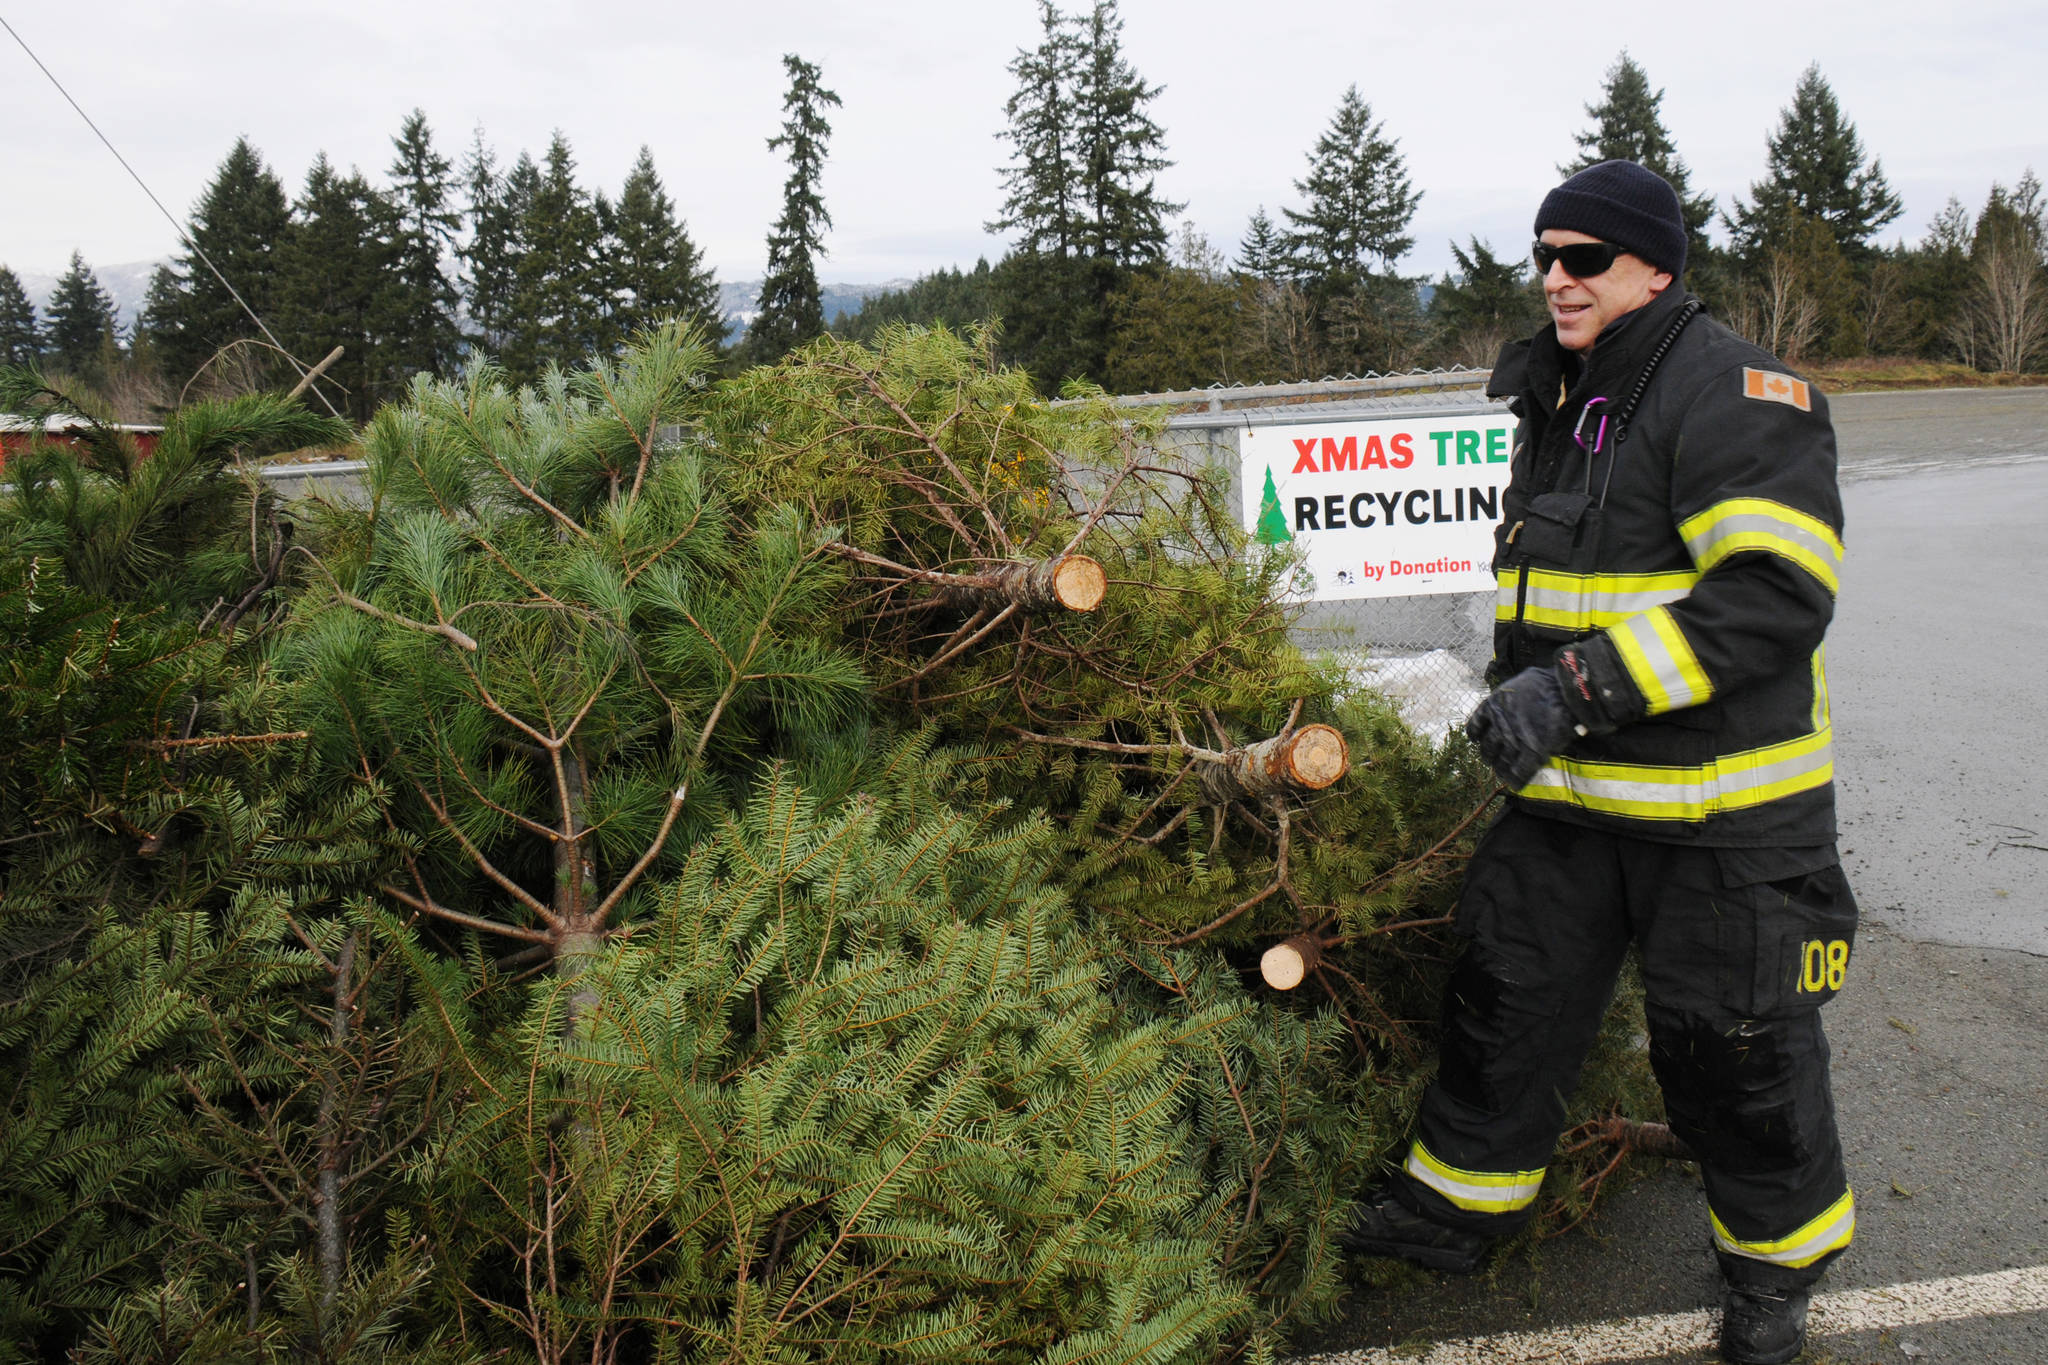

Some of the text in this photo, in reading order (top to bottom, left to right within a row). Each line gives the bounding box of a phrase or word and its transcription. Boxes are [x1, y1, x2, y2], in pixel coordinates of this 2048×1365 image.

[1292, 428, 1516, 474] XMAS TRE
[1295, 486, 1499, 531] RECYCLIN
[1364, 561, 1385, 581] by
[1390, 557, 1471, 576] Donation
